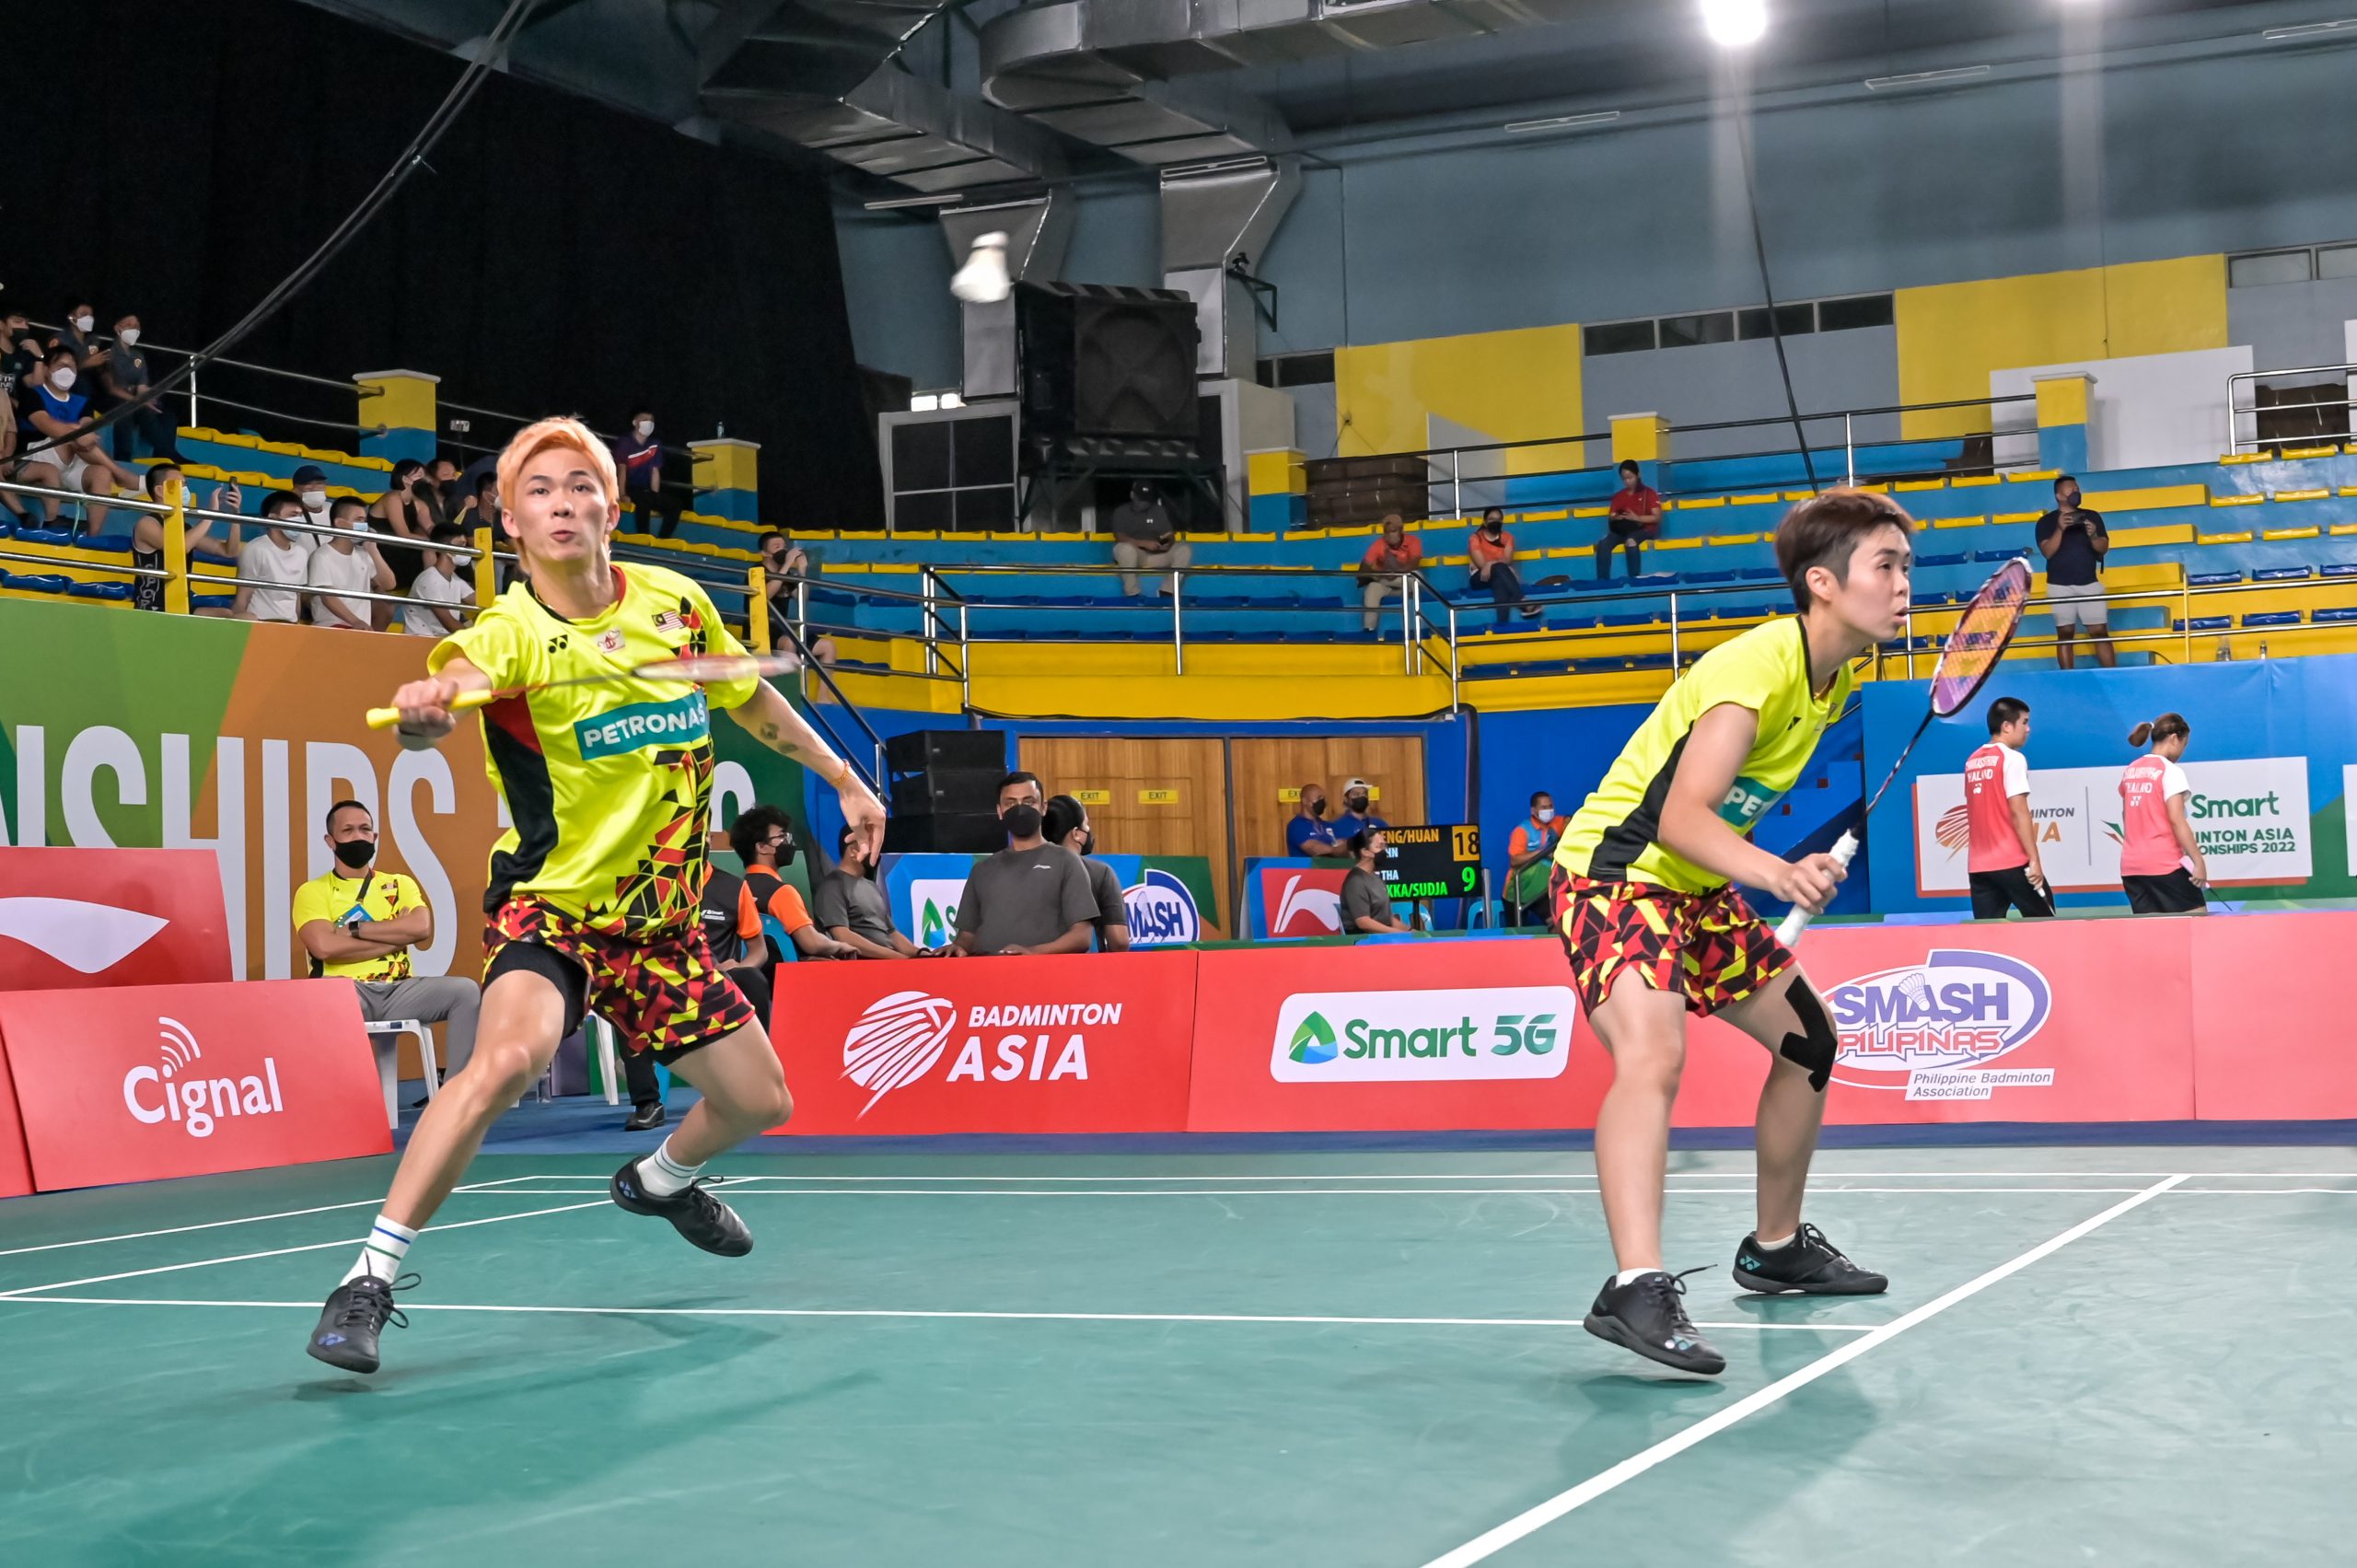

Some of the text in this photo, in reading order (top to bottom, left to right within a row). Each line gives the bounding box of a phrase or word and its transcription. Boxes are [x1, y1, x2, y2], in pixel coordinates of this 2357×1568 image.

[583, 703, 705, 748] PETRONAS
[1148, 791, 1167, 799] EXIT
[2190, 791, 2280, 819] Smart
[1455, 831, 1480, 855] 18
[2253, 828, 2294, 841] ASIA
[2261, 841, 2296, 853] 2022
[1461, 866, 1476, 892] 9
[969, 1003, 1122, 1028] BADMINTON
[1833, 981, 2009, 1025] SMASH
[1342, 1014, 1557, 1059] Smart 5G
[1838, 1029, 2002, 1056] PILIPINAS
[946, 1034, 1088, 1082] ASIA
[1913, 1073, 2051, 1086] Philippine Badminton
[1913, 1086, 1989, 1097] Association
[123, 1056, 284, 1138] Cignal
